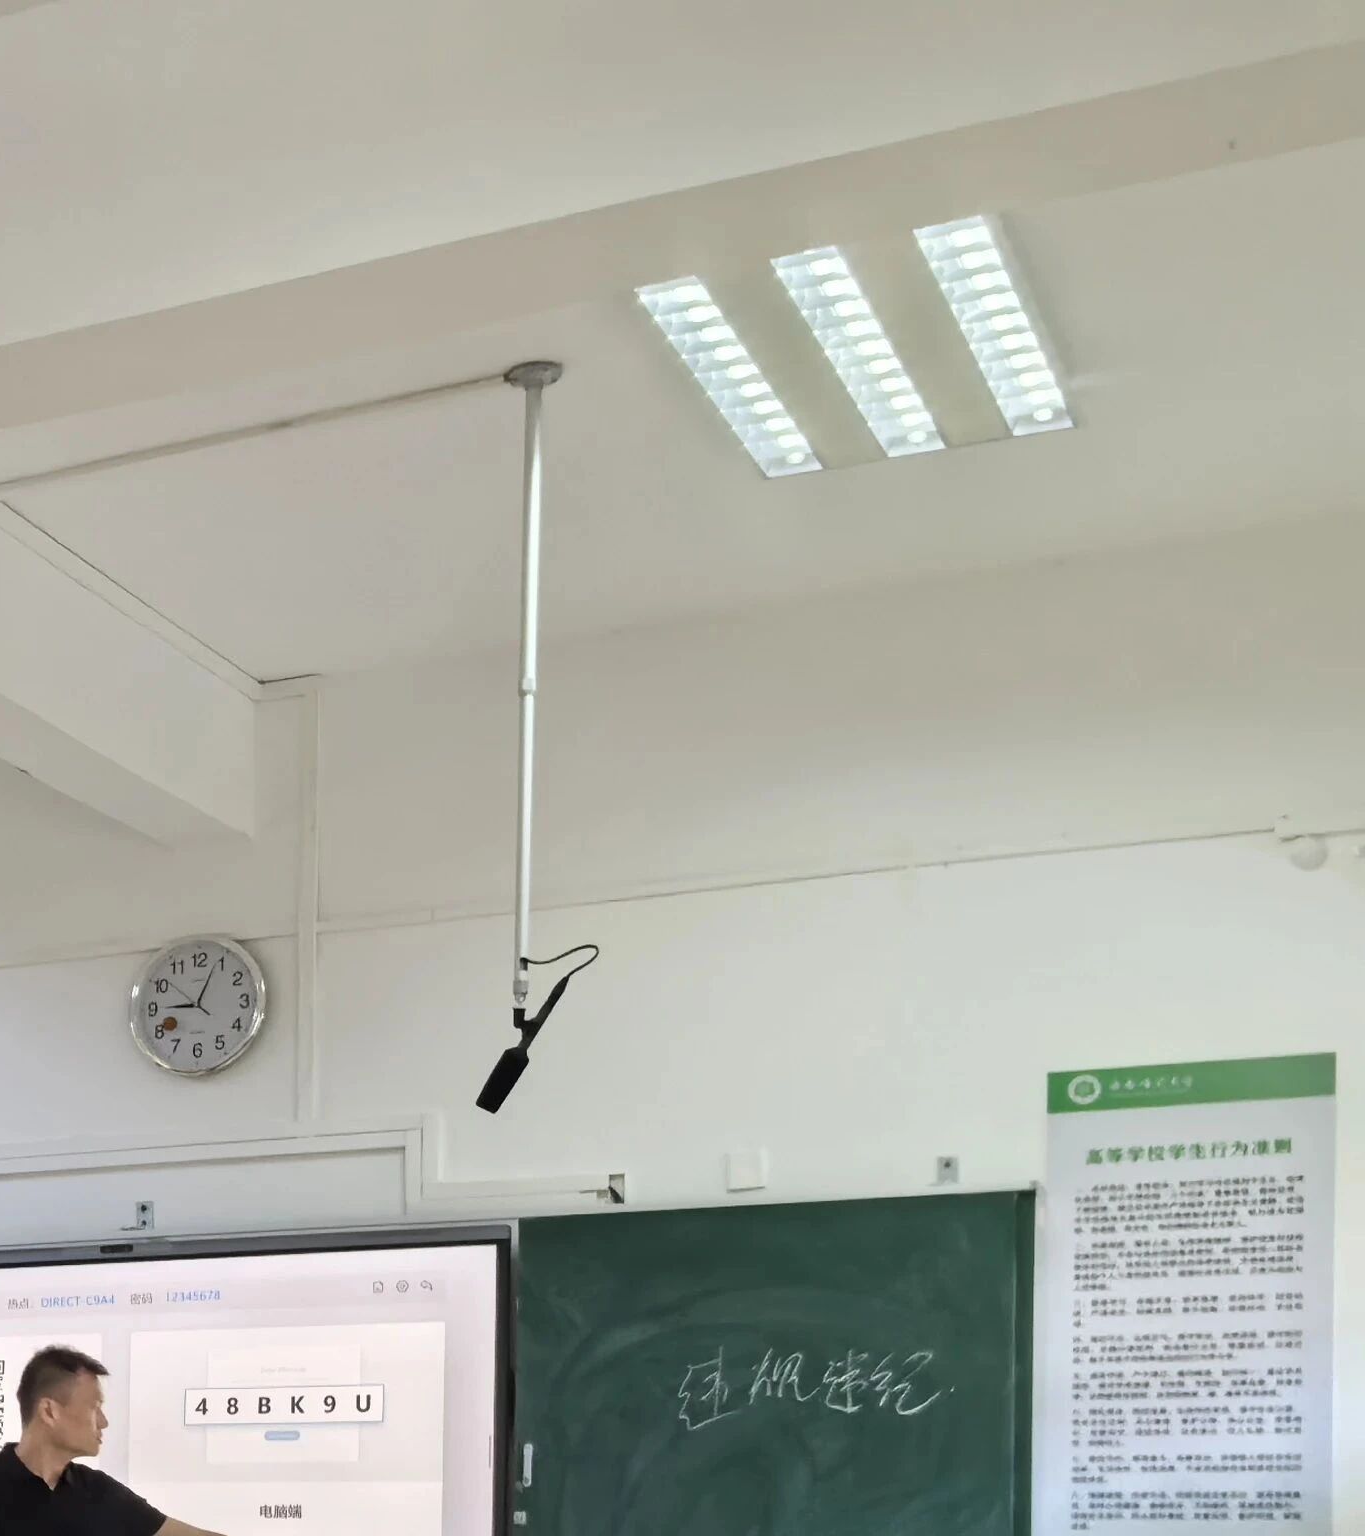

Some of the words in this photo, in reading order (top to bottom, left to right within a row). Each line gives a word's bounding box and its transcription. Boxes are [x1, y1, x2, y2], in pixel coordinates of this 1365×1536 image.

[170, 960, 184, 975] 11
[192, 952, 208, 968] 12
[219, 957, 225, 971] 1
[154, 979, 168, 993] 10
[232, 971, 244, 986] 2
[239, 993, 250, 1009] 3
[148, 1002, 158, 1017] 9
[155, 1024, 165, 1039] 8
[231, 1018, 243, 1032] 4
[171, 1039, 181, 1053] 7
[215, 1035, 225, 1050] 5
[192, 1043, 203, 1058] 6
[165, 1290, 221, 1303] 12345678
[259, 1503, 302, 1520] 电脑端
